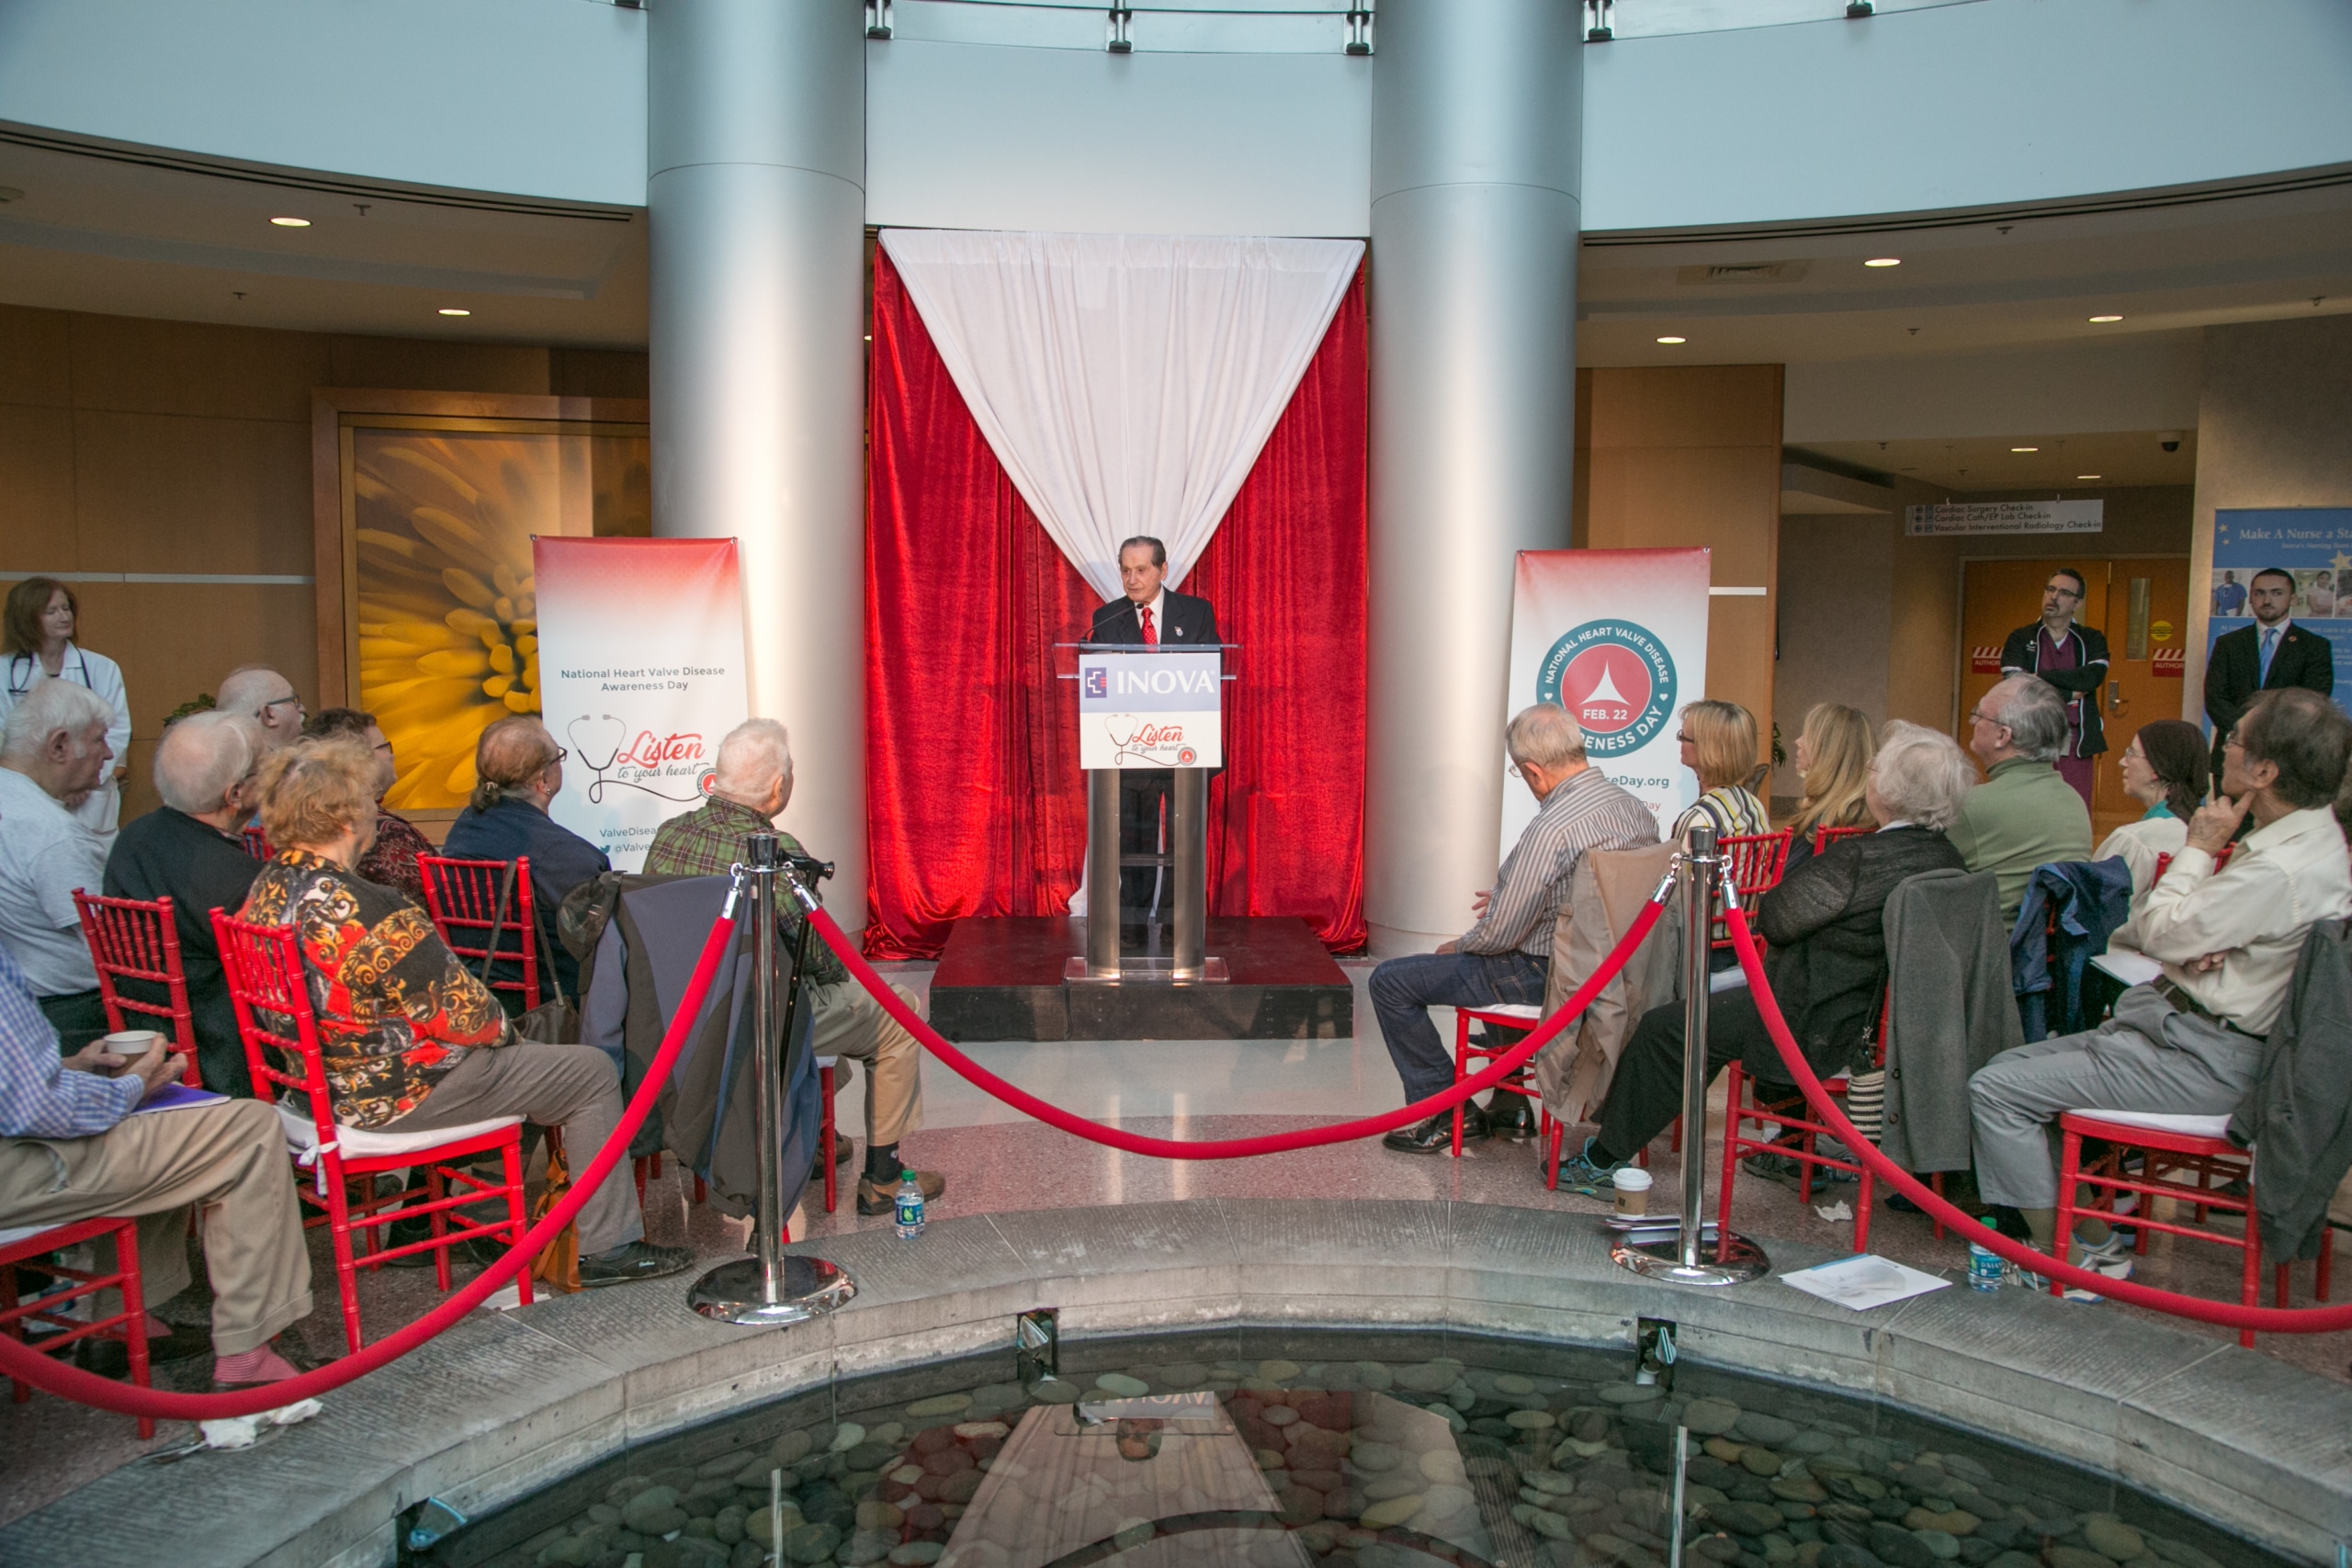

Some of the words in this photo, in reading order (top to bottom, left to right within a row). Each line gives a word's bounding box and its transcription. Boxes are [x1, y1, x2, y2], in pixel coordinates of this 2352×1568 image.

[1935, 505, 1965, 513] Cardiac
[1967, 504, 1998, 514] Surgery
[2000, 503, 2033, 513] Check-in
[2018, 512, 2051, 520] Check-in
[1969, 522, 2021, 530] Interventional
[2024, 521, 2064, 531] Radiology
[2067, 520, 2101, 529] Check-in
[2239, 528, 2271, 539] Make
[2274, 528, 2283, 539] A
[2286, 528, 2323, 539] Nurse
[2326, 531, 2334, 539] a
[1545, 639, 1578, 684] NATIONAL
[1577, 626, 1612, 643] HEART
[1615, 627, 1646, 647] VALVE
[1644, 643, 1669, 684] DISEASE
[561, 668, 610, 679] National
[614, 668, 645, 678] Heart
[648, 667, 679, 677] Valve
[683, 666, 725, 676] Disease
[601, 682, 664, 692] Awareness
[668, 681, 689, 692] Day
[1583, 709, 1610, 720] FEB.
[1612, 709, 1628, 720] 22
[1635, 705, 1662, 736] DAY
[1132, 723, 1184, 747] Listen
[617, 730, 706, 769] Listen
[1132, 743, 1143, 751] to
[1141, 744, 1157, 754] your
[1160, 743, 1186, 751] heart
[617, 766, 636, 779] to
[634, 767, 662, 784] your
[666, 762, 709, 777] heart
